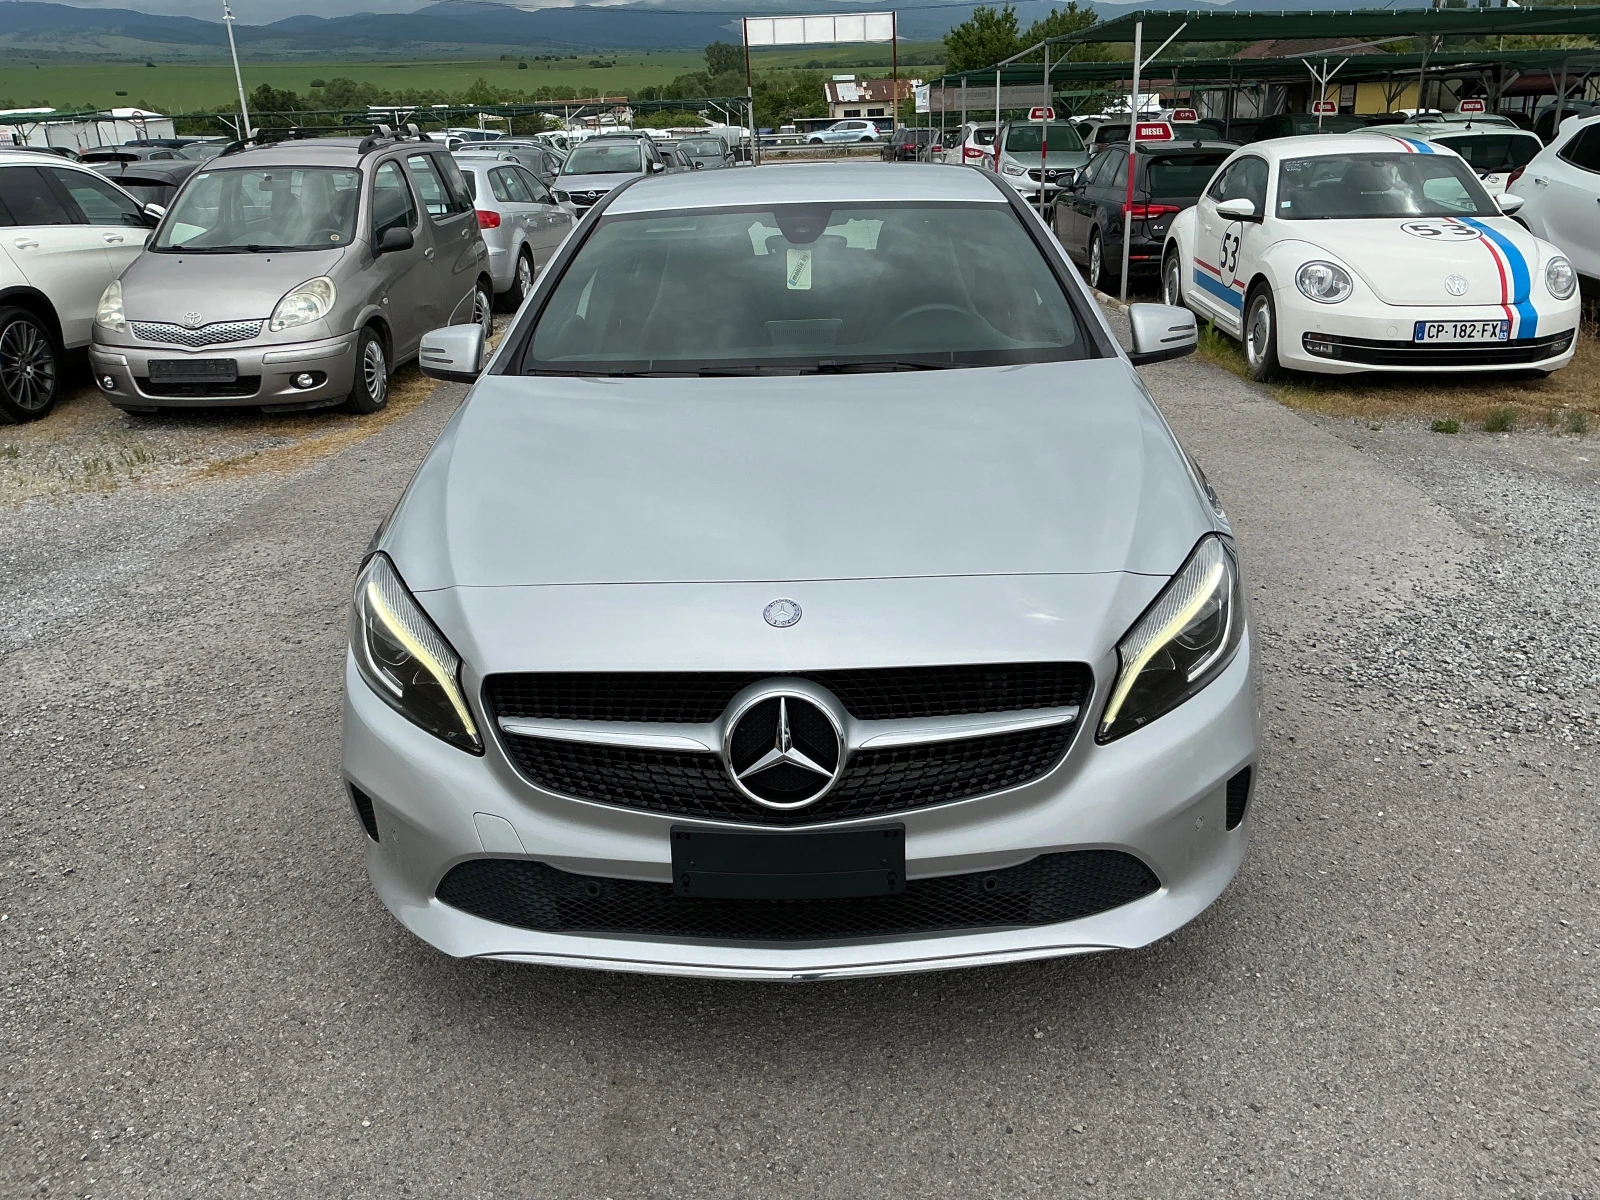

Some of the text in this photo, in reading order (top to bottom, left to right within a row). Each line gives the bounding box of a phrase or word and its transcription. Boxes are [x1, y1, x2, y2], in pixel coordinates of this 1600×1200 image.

[1141, 127, 1164, 136] DIESEL
[1409, 224, 1477, 236] 53
[1220, 232, 1240, 273] 53
[1427, 323, 1499, 339] CP-182-FX
